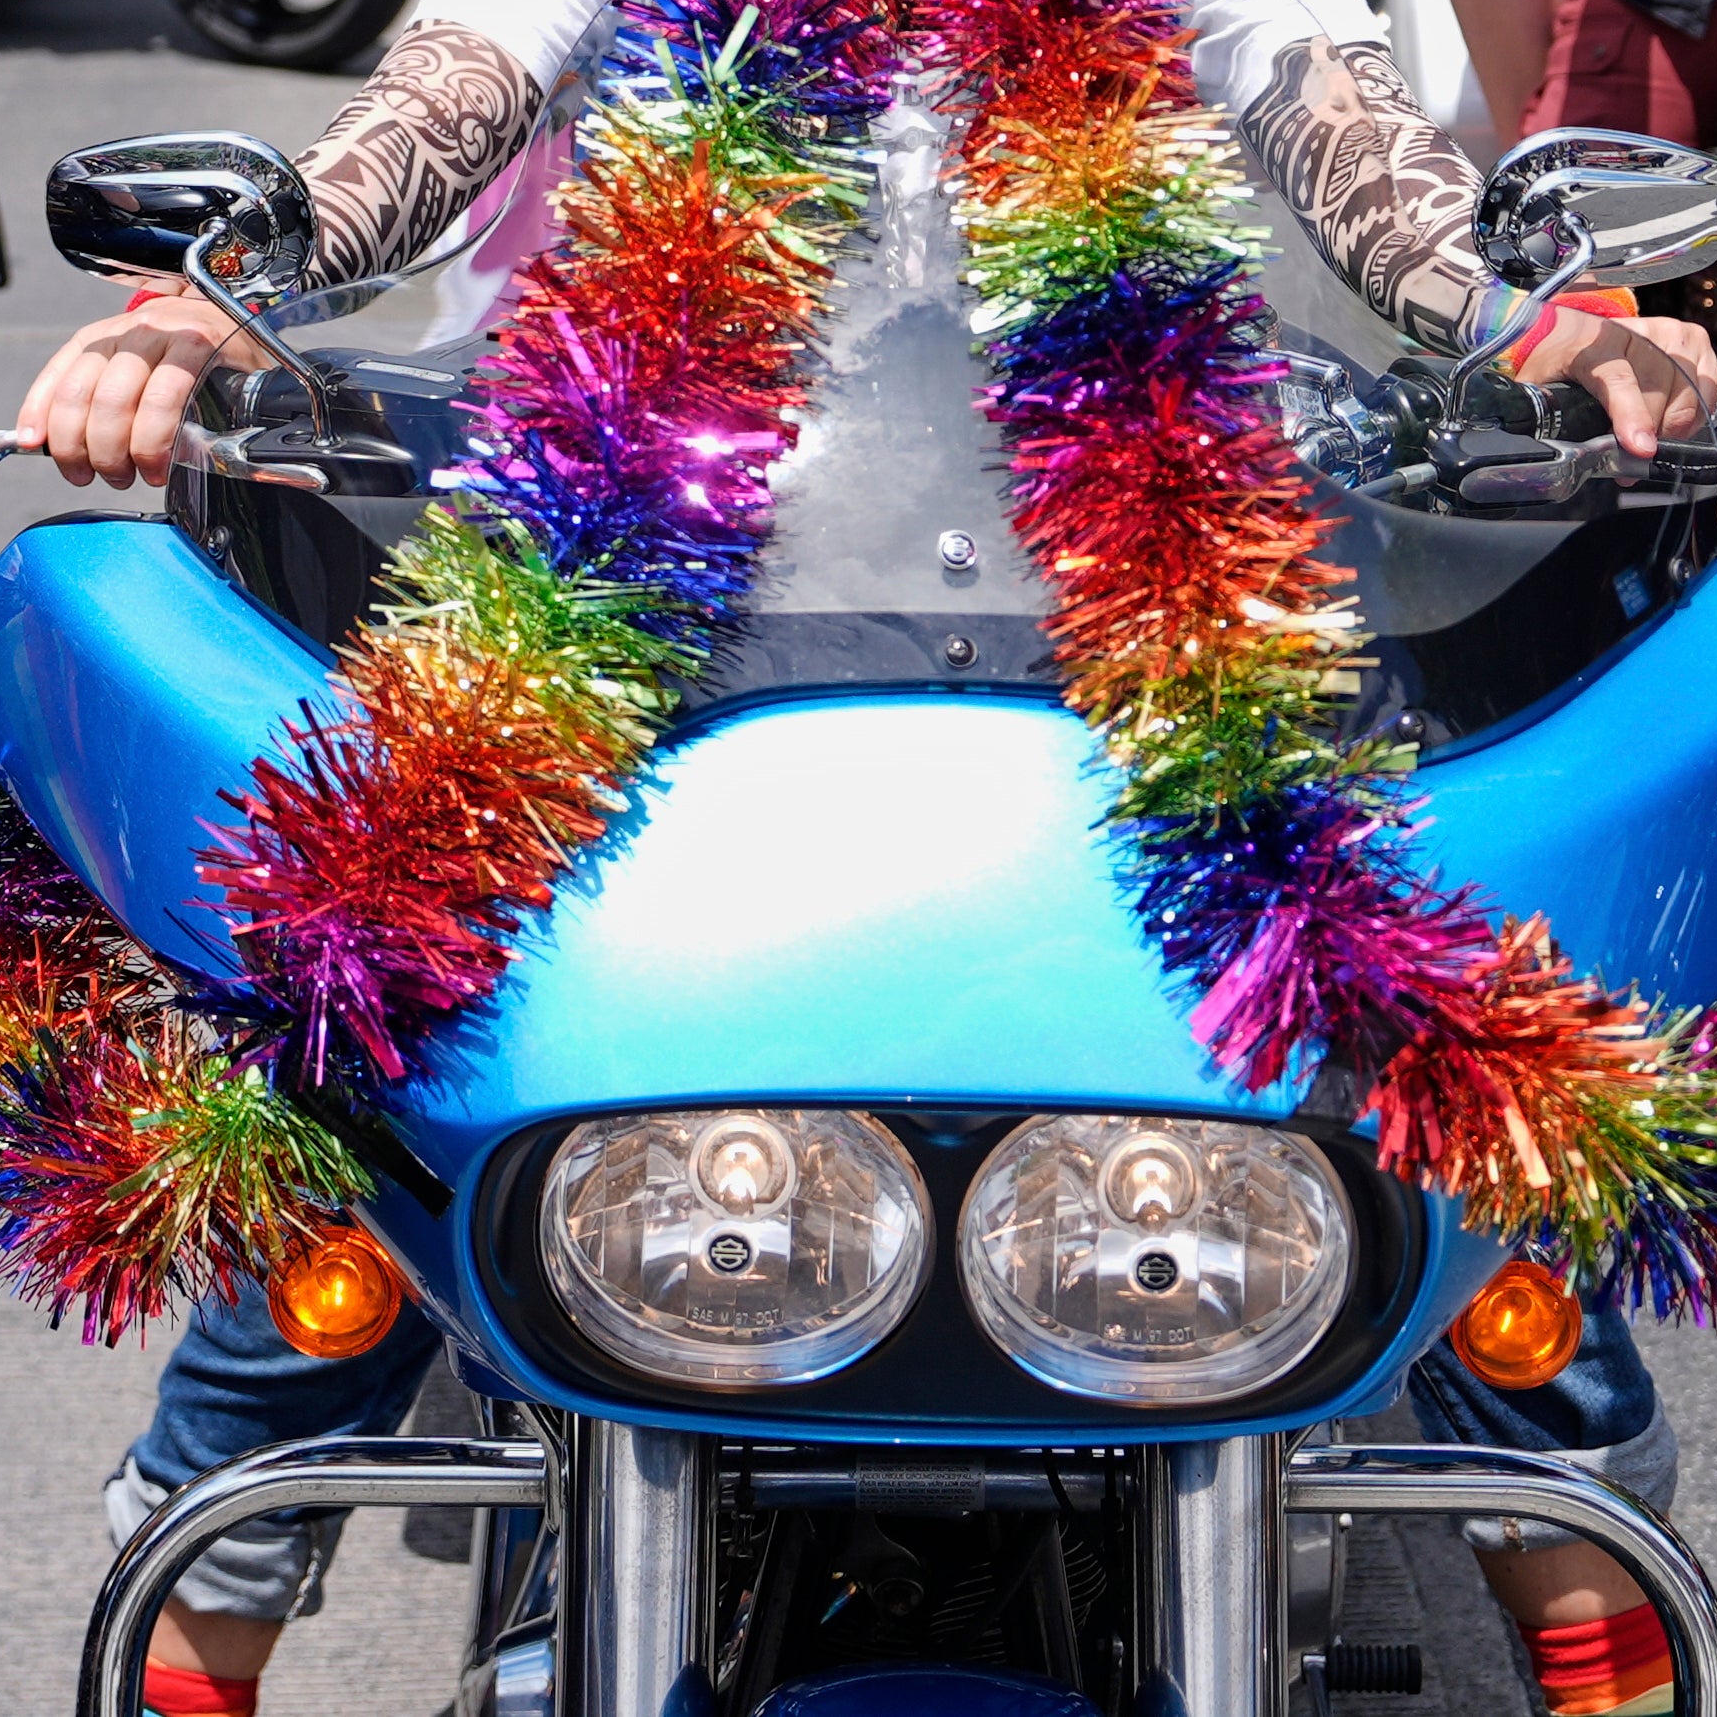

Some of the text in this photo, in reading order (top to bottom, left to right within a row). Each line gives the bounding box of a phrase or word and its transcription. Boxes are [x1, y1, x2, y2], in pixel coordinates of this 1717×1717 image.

[691, 1306, 715, 1323] SAE
[755, 1308, 780, 1326] DOT
[1168, 1326, 1192, 1343] DOT
